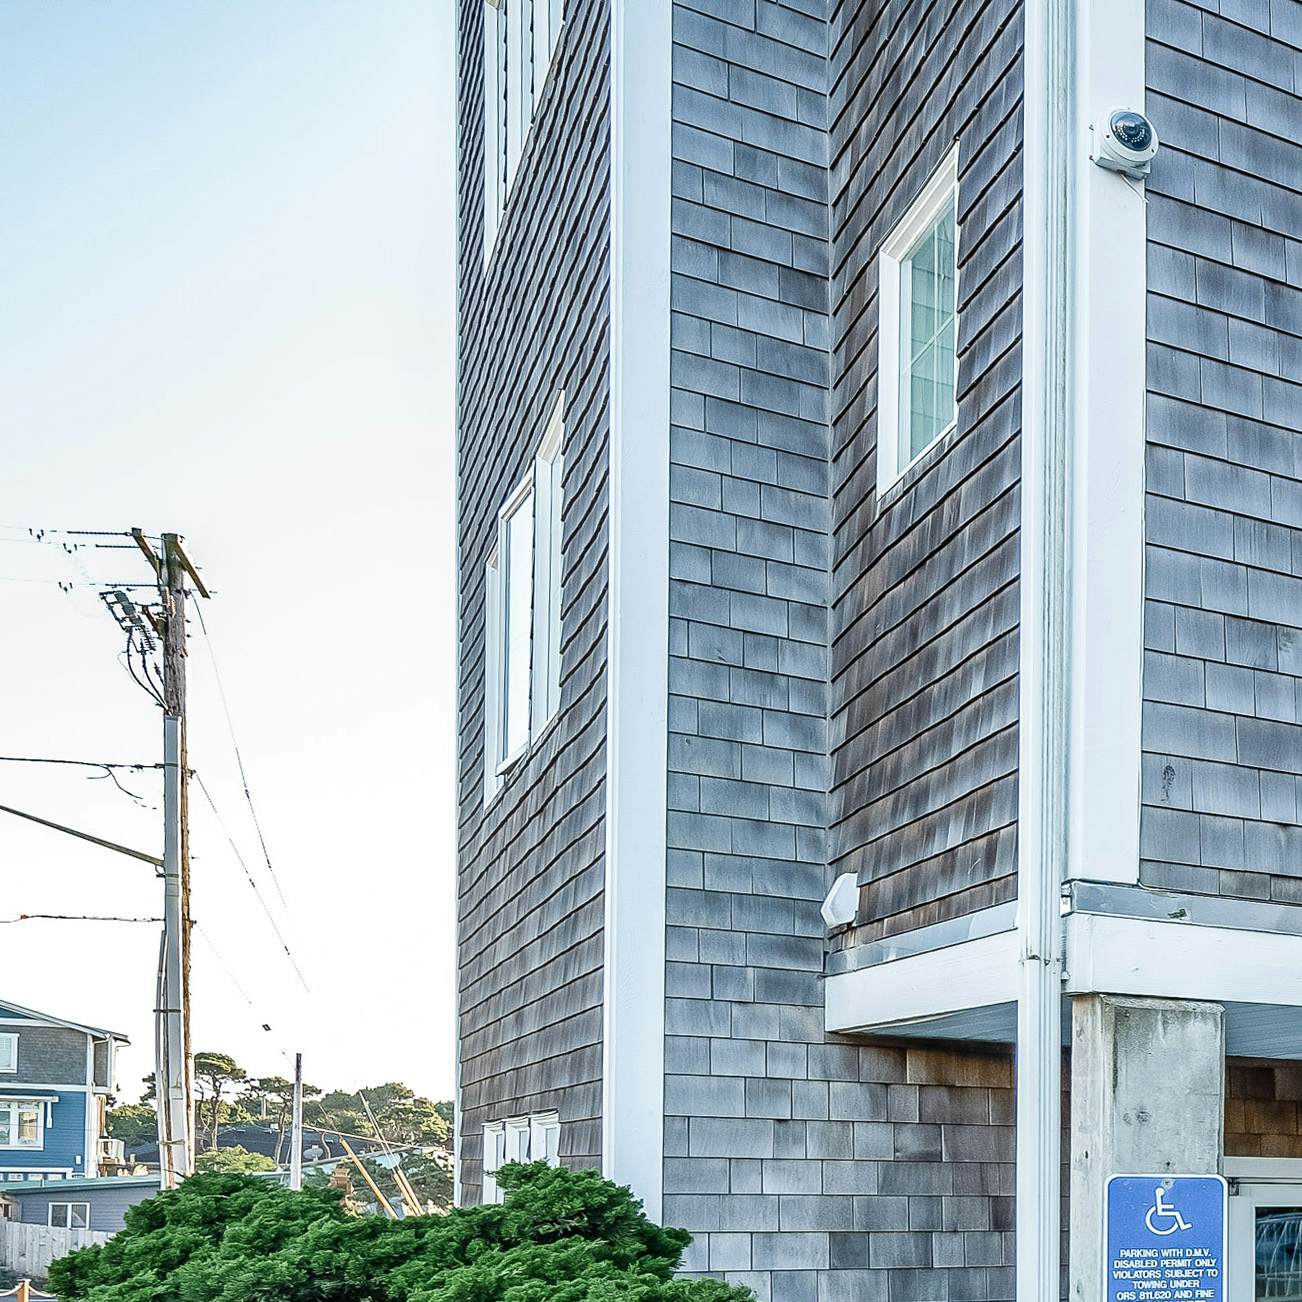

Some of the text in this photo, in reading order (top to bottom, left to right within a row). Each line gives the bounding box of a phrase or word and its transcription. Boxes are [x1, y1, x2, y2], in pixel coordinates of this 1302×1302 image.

[1120, 1248, 1212, 1258] PARKING WITH D.M.V.
[1114, 1258, 1217, 1269] DISABLED PERMIT ONLY
[1113, 1269, 1218, 1279] VIOLATORS SUBJECT TO
[1132, 1279, 1200, 1289] TOWING UNDER
[1116, 1289, 1215, 1301] ORS 811.620 AND FINE
